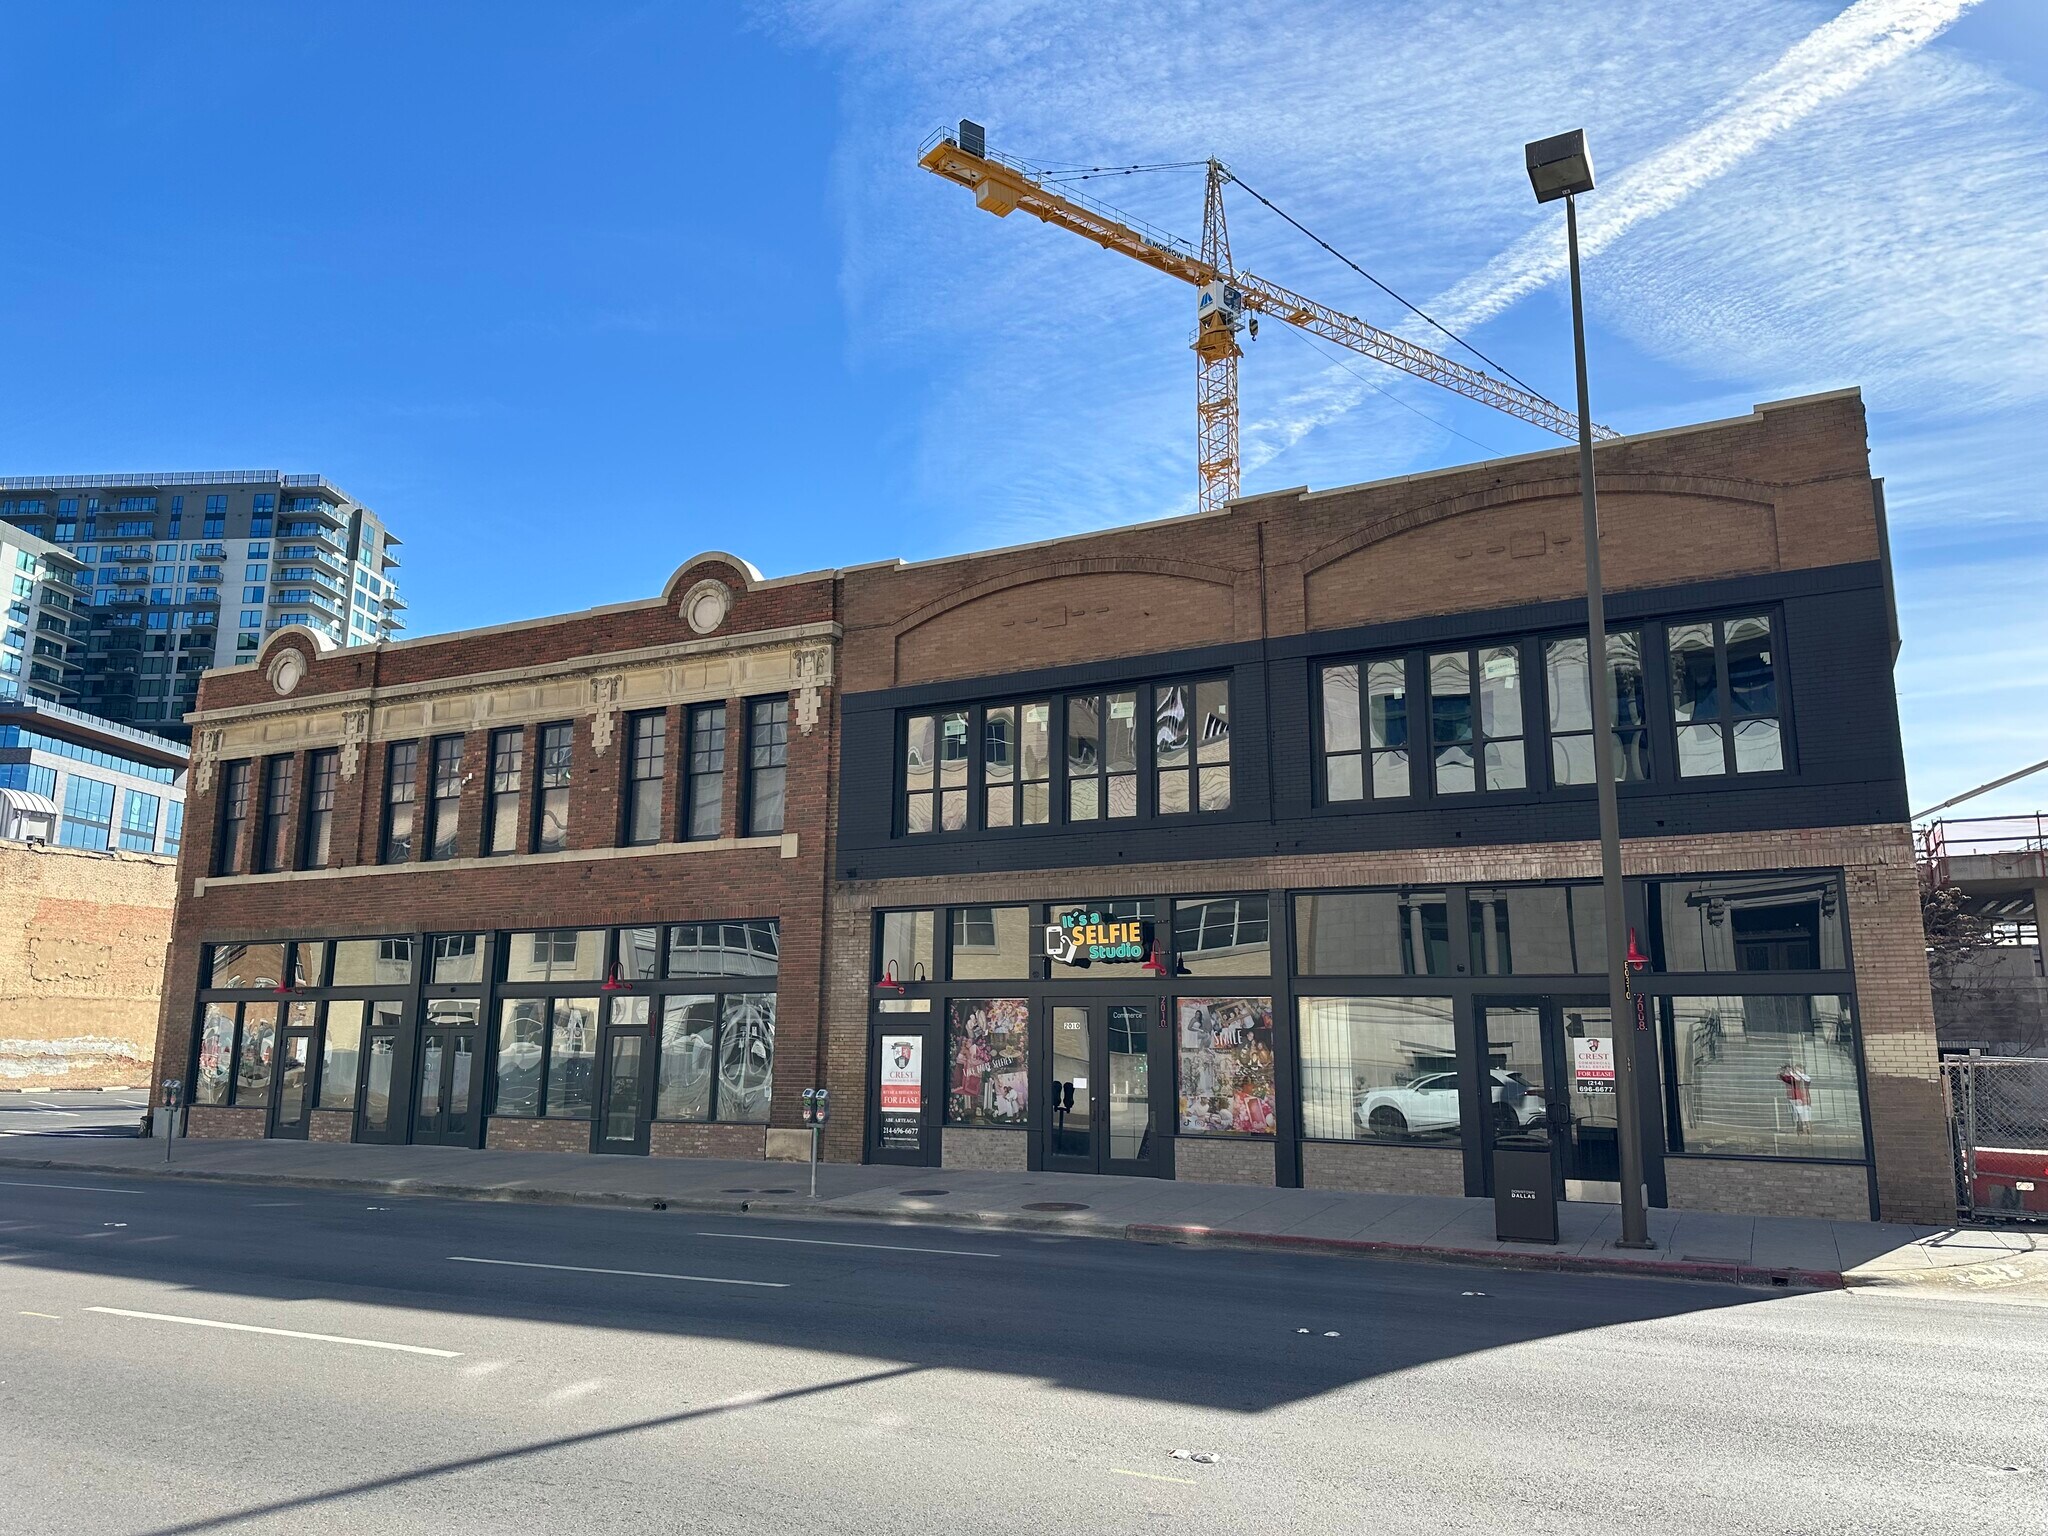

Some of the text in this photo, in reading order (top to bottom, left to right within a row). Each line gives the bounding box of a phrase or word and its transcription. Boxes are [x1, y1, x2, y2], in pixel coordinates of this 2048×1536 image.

[1153, 242, 1183, 259] MORROW
[1090, 912, 1100, 924] a
[1072, 922, 1141, 946] SELFIE
[1089, 942, 1142, 959] Studio
[1113, 1011, 1143, 1019] Commerce
[1637, 993, 1646, 1031] 2008
[1063, 1022, 1081, 1030] 2010
[1213, 1030, 1243, 1046] SMILE
[889, 1071, 914, 1079] CREST
[883, 1096, 919, 1105] FOR LEASE
[883, 1126, 919, 1135] 214-696-6677
